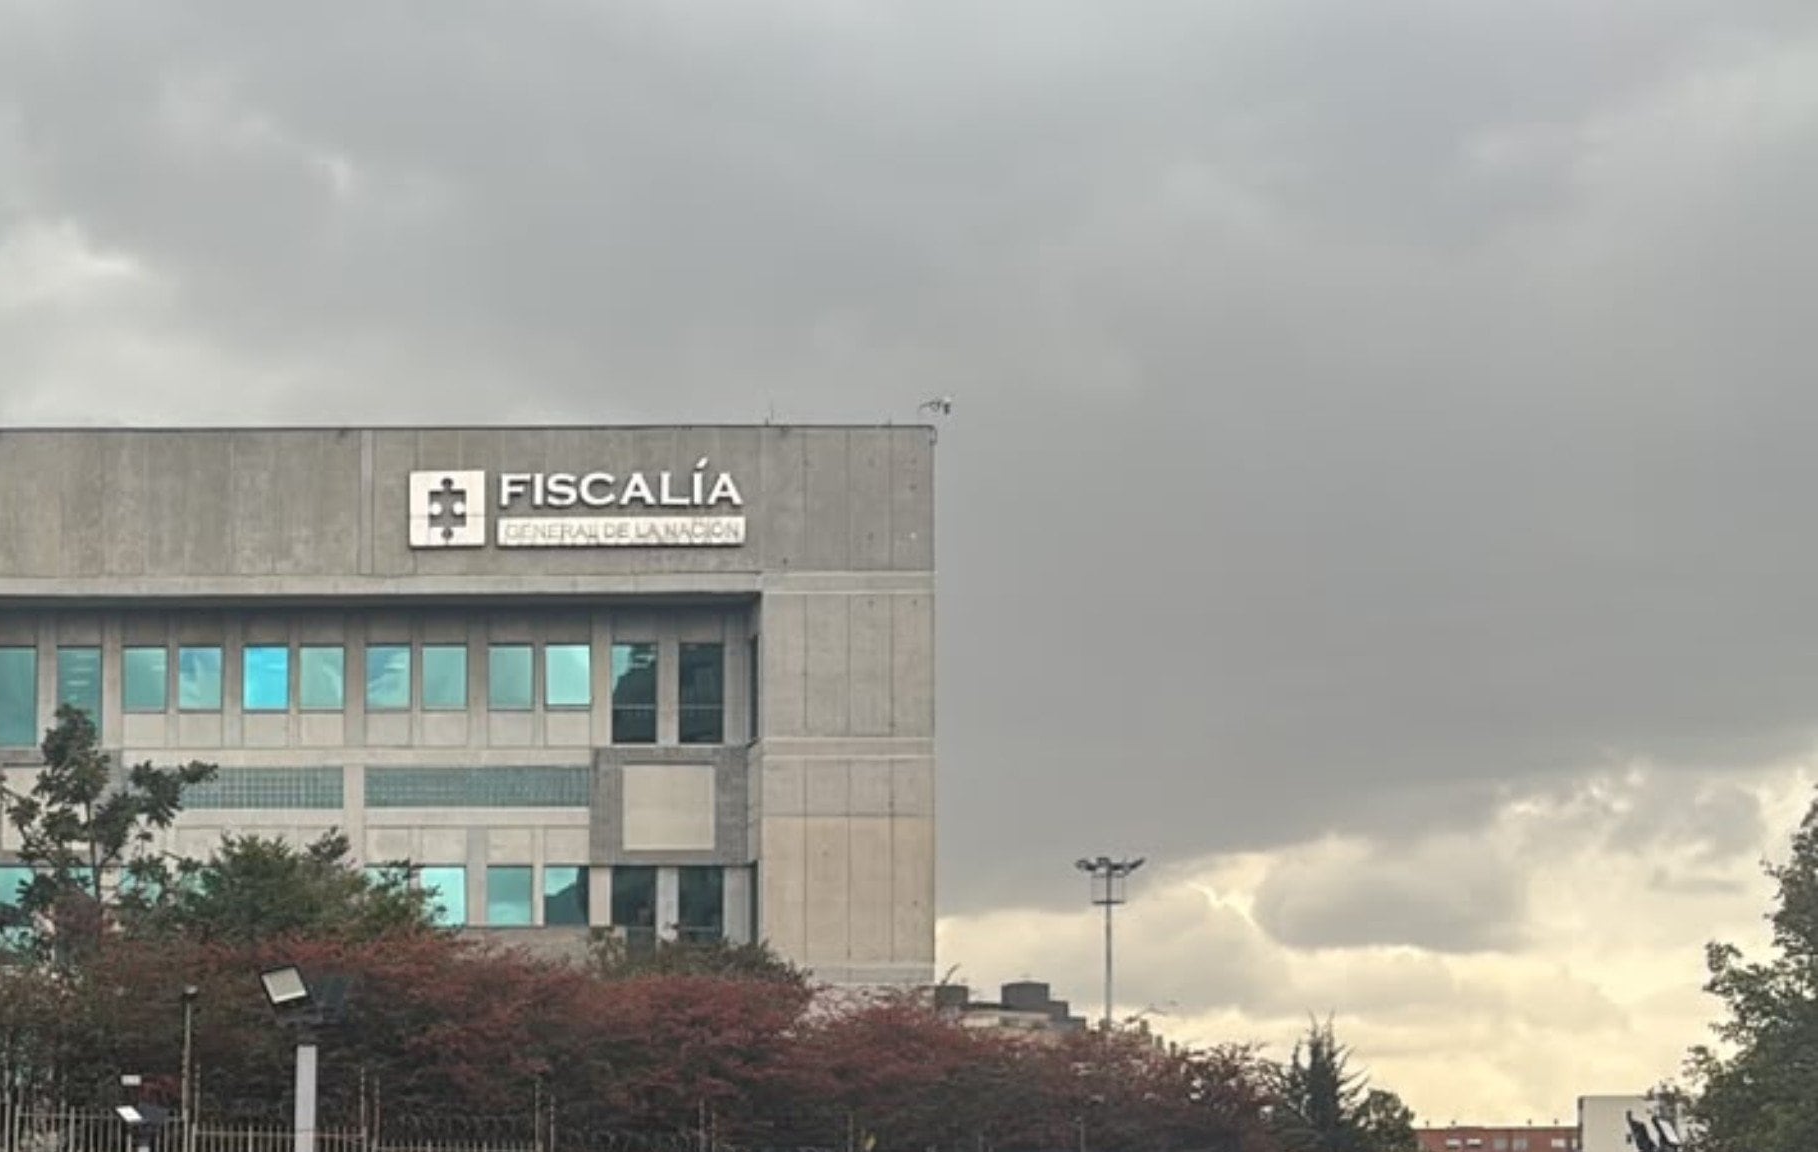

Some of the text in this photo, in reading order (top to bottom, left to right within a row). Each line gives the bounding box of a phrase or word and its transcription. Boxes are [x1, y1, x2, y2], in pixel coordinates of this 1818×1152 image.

[499, 457, 744, 506] FISCALÍA
[505, 522, 598, 539] GENERAL
[603, 522, 631, 539] DE
